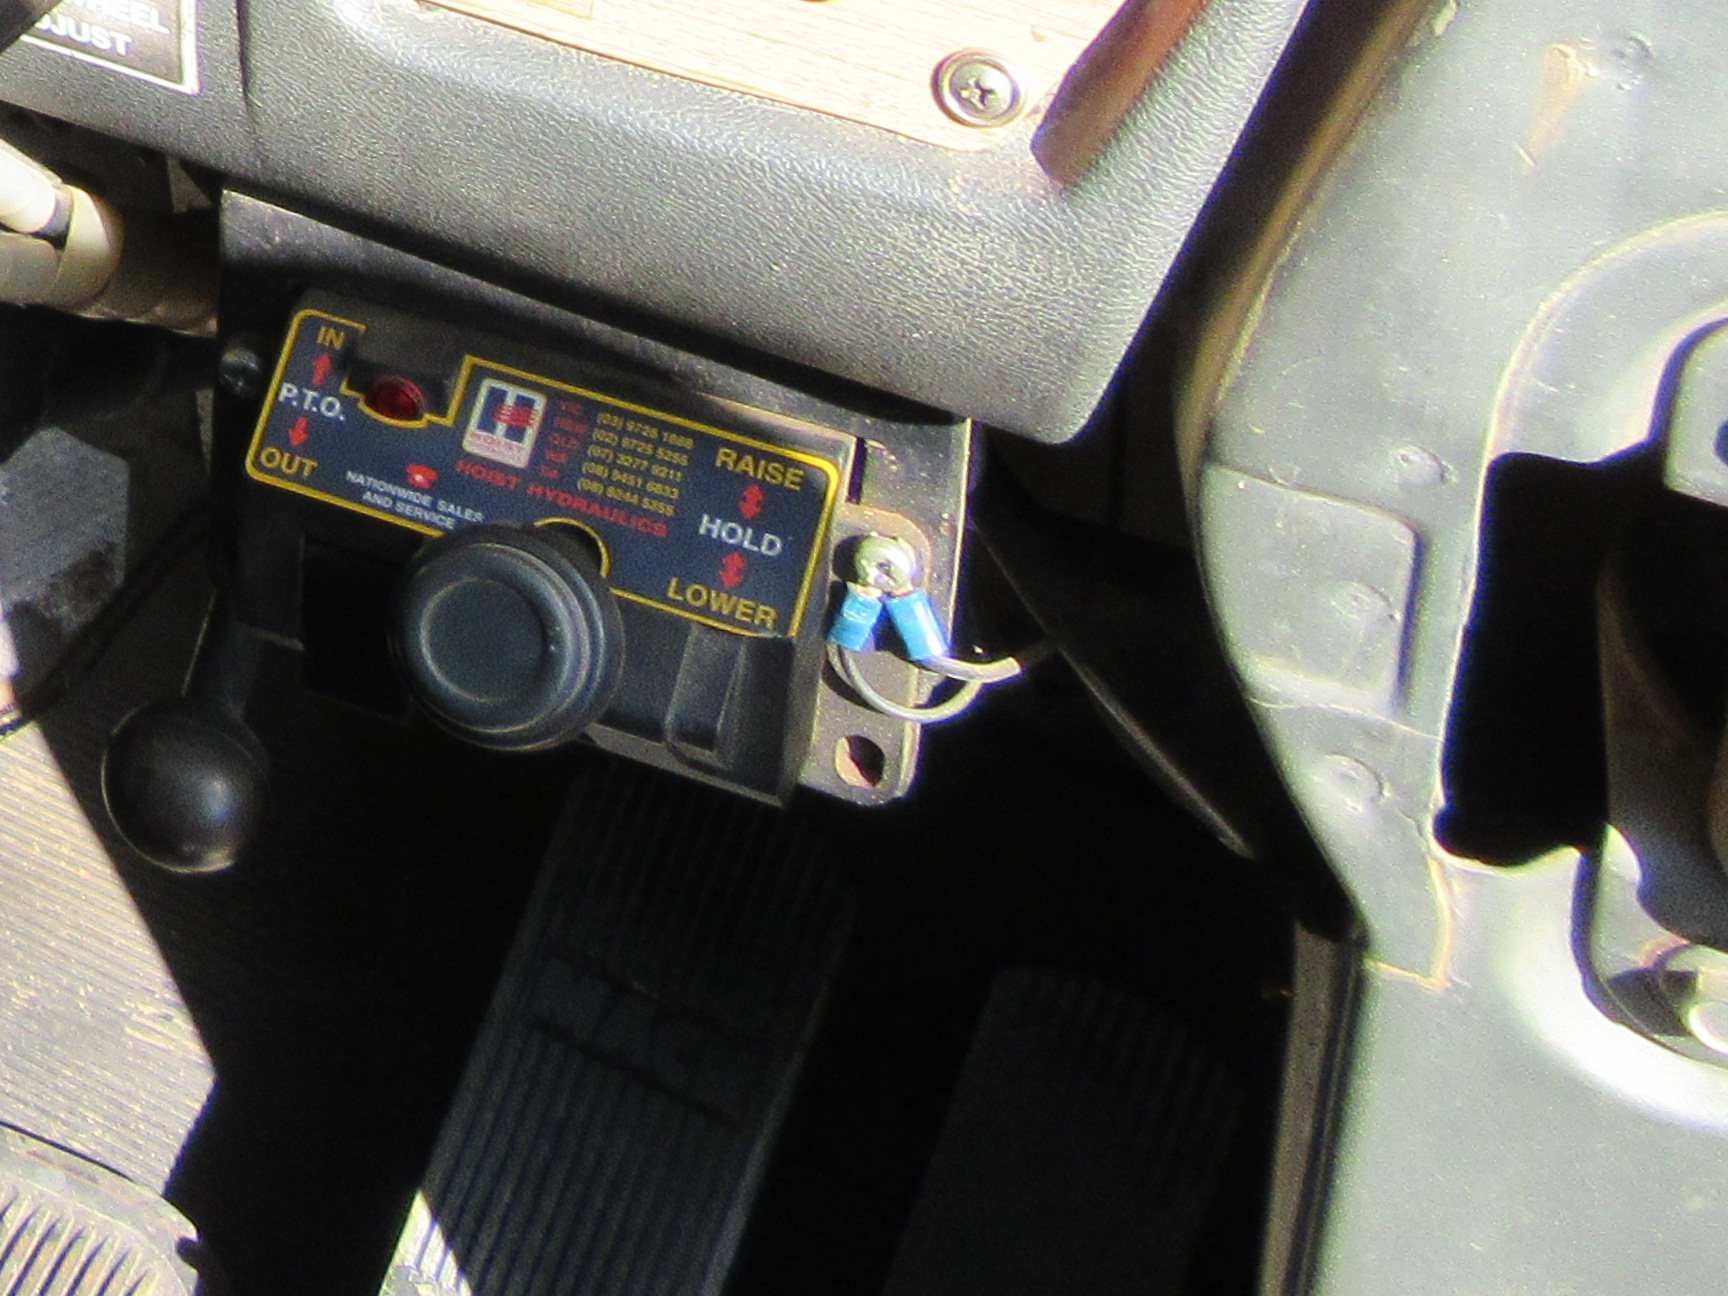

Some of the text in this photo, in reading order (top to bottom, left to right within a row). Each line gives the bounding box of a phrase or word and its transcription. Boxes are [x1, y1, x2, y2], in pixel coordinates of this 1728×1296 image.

[317, 326, 346, 350] IN
[277, 382, 346, 421] P.T.O.
[259, 446, 320, 477] OUT
[714, 447, 805, 491] RAISE
[345, 470, 485, 524] NATIONWIDE SALES
[362, 491, 456, 530] AND SERVICE
[455, 460, 668, 538] HOIST HYDRAULICS
[698, 513, 783, 557] HOLD
[667, 576, 779, 630] LOWER
